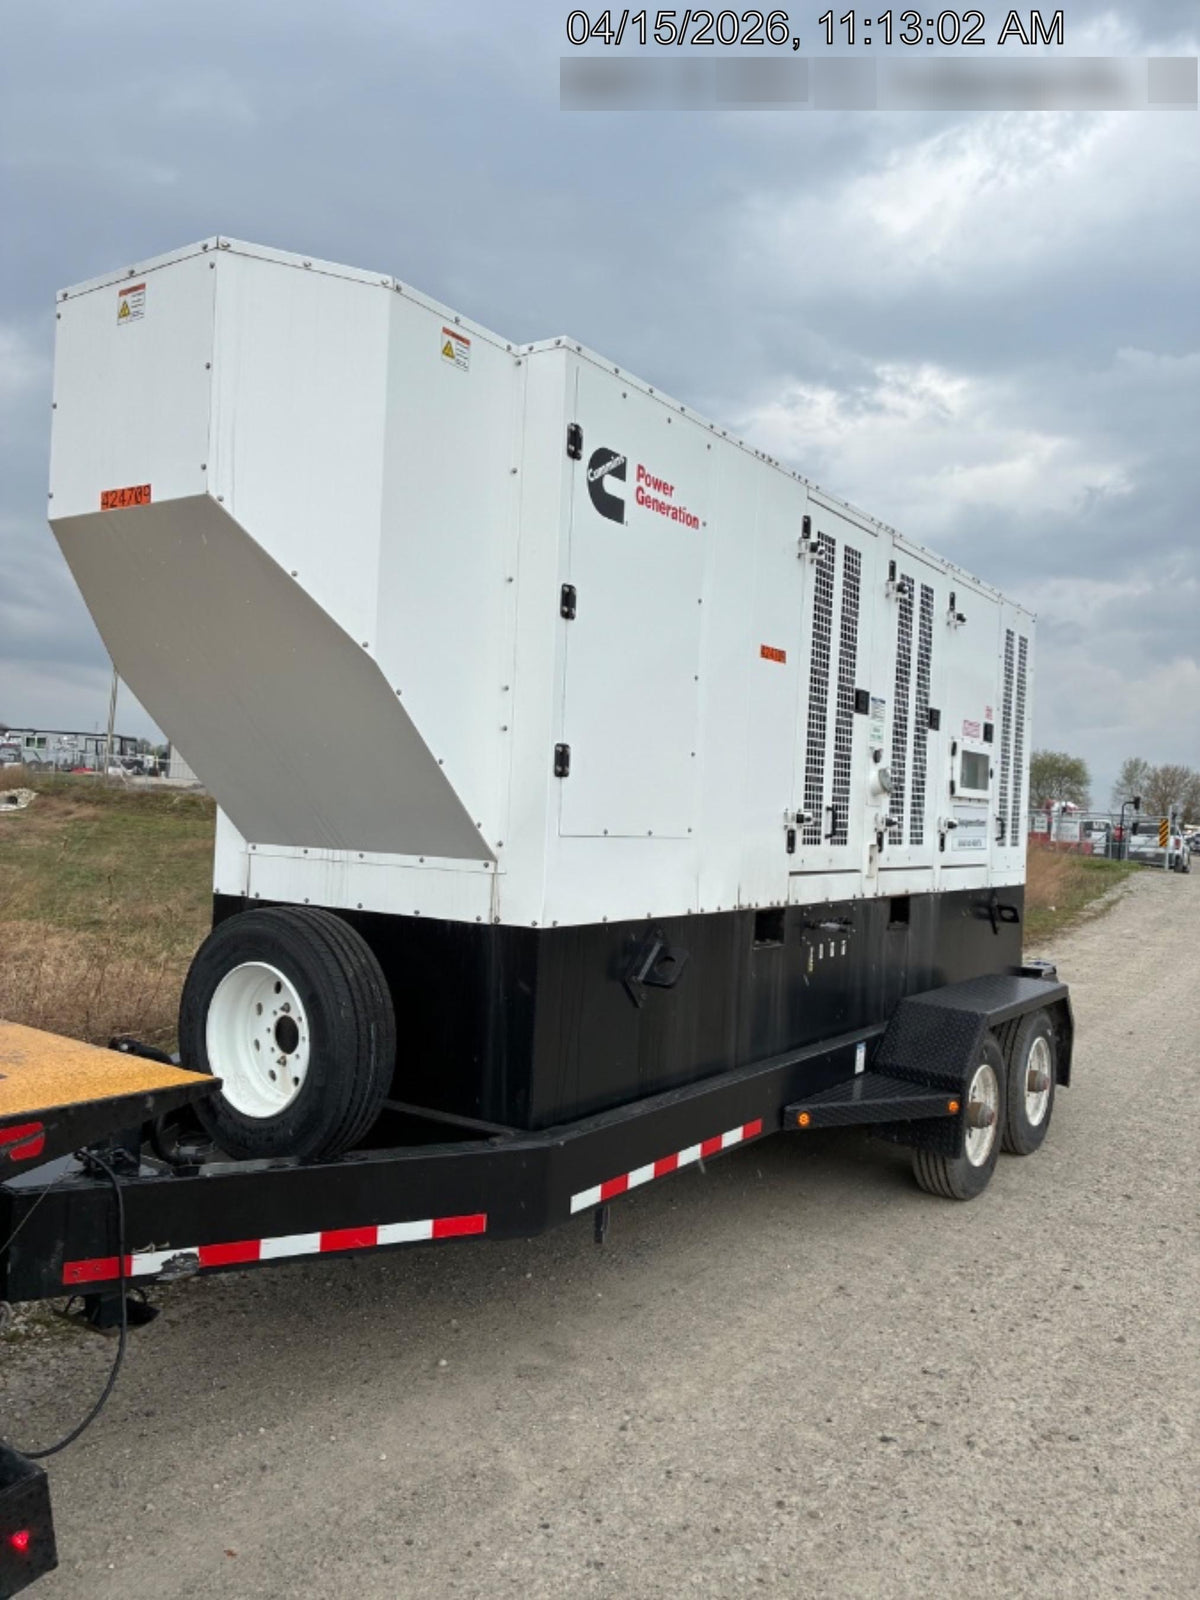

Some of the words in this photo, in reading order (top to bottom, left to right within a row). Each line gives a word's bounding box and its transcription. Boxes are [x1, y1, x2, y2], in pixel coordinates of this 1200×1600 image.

[101, 484, 151, 510] 424709
[636, 463, 675, 498] Power
[635, 485, 700, 530] Generation
